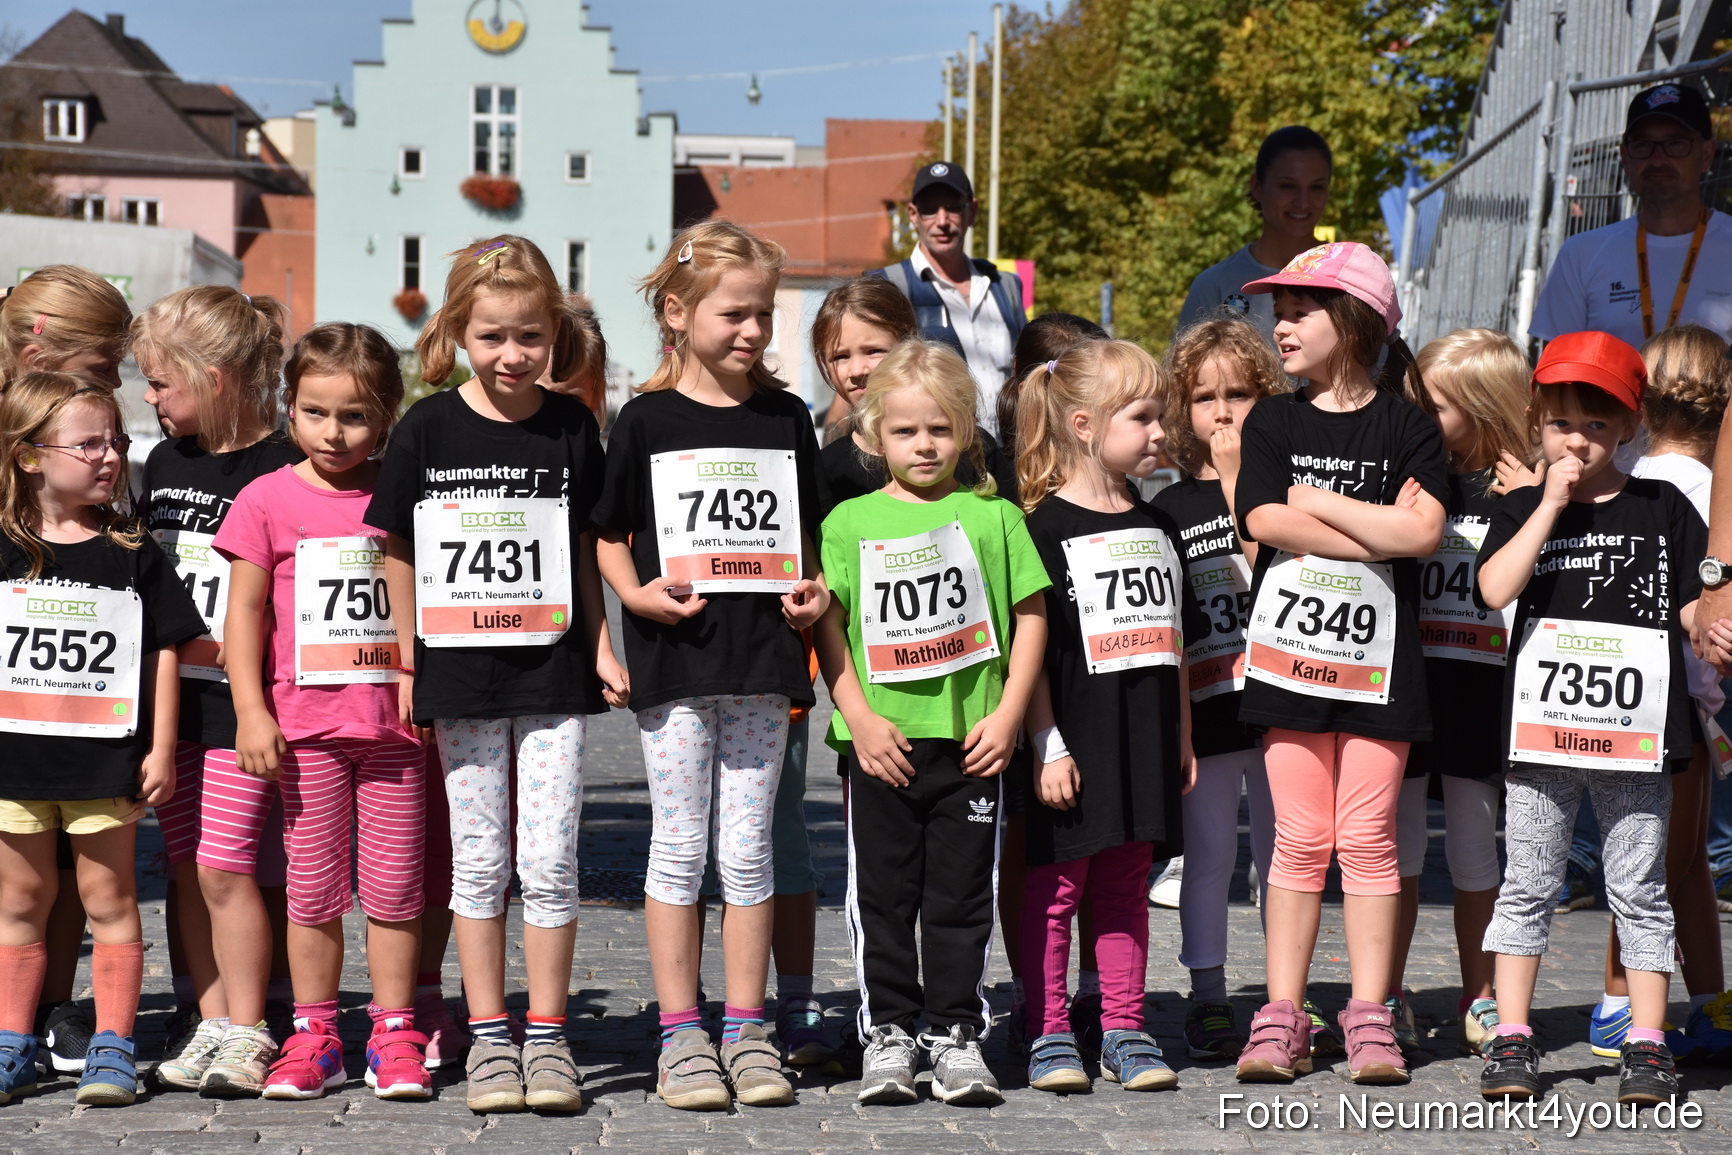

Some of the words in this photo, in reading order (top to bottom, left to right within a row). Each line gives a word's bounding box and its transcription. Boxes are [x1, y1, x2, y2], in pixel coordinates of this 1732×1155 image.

[425, 465, 529, 483] Neumarkter
[697, 462, 758, 477] BOCK
[461, 511, 527, 527] BOCK
[678, 488, 781, 533] 7432
[664, 527, 674, 535] B1
[1180, 514, 1235, 540] umarkt
[692, 538, 723, 547] PARTL
[725, 538, 764, 547] Neumarkt
[1108, 540, 1161, 557] BOCK
[1438, 536, 1480, 551] OCK
[440, 539, 542, 584] 7431
[711, 557, 762, 575] Emma
[884, 544, 942, 569] BOCK
[1533, 552, 1603, 576] tadtlauf
[423, 576, 433, 584] B1
[1190, 567, 1235, 588] OCK
[1300, 567, 1363, 591] BOCK
[1658, 535, 1670, 621] BAMBINI
[451, 591, 483, 600] PARTL
[485, 591, 530, 600] Neumarkt
[874, 566, 967, 624] 7073
[1094, 566, 1177, 611] 7501
[27, 598, 98, 617] BOCK
[319, 577, 391, 621] 750
[302, 613, 312, 621] B1
[473, 610, 523, 629] Luise
[1084, 606, 1094, 614] B1
[1257, 614, 1267, 623] B1
[1274, 587, 1377, 645] 7349
[1432, 607, 1474, 618] Neumarkt
[886, 628, 914, 639] PARTL
[915, 618, 956, 636] Neumarkt
[1113, 615, 1143, 625] PARTL
[328, 629, 361, 638] PARTL
[363, 628, 398, 637] Neumarkt
[1100, 632, 1164, 653] ISABELLA
[1419, 625, 1477, 645] ohanna
[6, 625, 117, 674] 7552
[894, 637, 965, 667] Mathilda
[1187, 647, 1207, 659] PARTL
[1208, 638, 1247, 652] Neumarkt
[1276, 636, 1307, 650] PARTL
[1308, 643, 1351, 659] Neumarkt
[1556, 633, 1623, 653] BOCK
[352, 648, 392, 667] Julia
[1292, 659, 1338, 684] Karla
[11, 677, 41, 687] PARTL
[44, 679, 91, 690] Neumarkt
[1537, 660, 1643, 711] 7350
[1520, 691, 1529, 700] B1
[1543, 710, 1569, 721] PARTL
[1571, 713, 1617, 725] Neumarkt
[1554, 730, 1613, 753] Liliane
[967, 813, 993, 823] adidas
[1256, 1016, 1272, 1025] FILA
